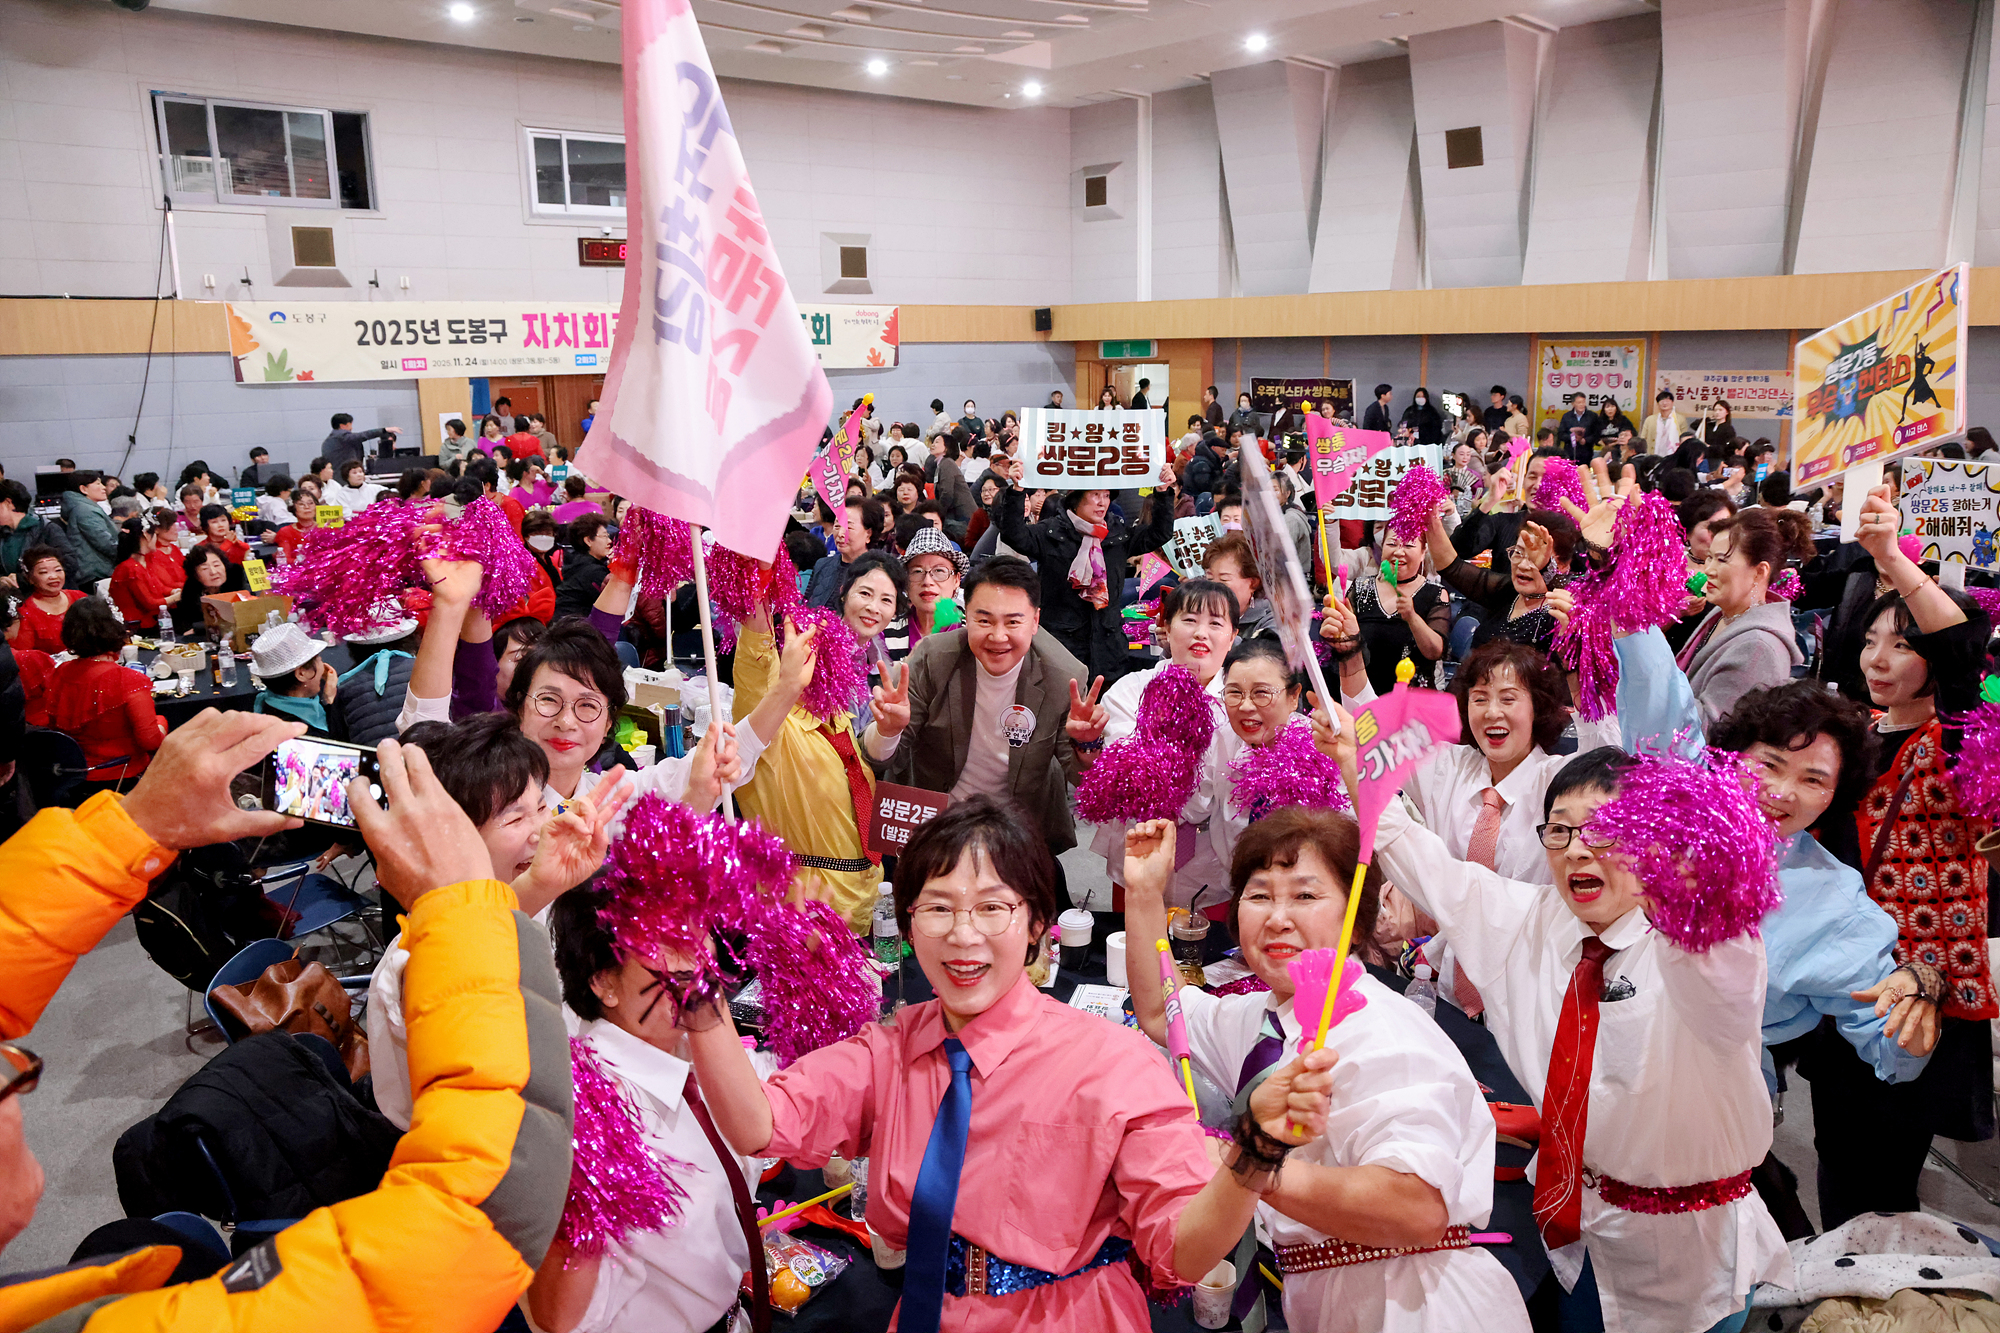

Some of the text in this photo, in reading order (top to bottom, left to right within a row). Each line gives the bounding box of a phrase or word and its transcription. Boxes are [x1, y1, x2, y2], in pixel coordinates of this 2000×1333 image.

[292, 312, 327, 325] 도봉구
[856, 309, 879, 318] dobong
[355, 312, 831, 349] 2025년 도봉구 자치회 회
[380, 360, 398, 370] 일시
[1825, 341, 1877, 385] 쌍문2동
[1675, 386, 1725, 401] 춤신춤왕
[1047, 422, 1142, 444] 킹 왕 짱
[1917, 422, 1928, 434] 댄스
[1037, 444, 1150, 476] 쌍문2동
[1375, 458, 1392, 478] 왕
[1949, 484, 1967, 493] 너~무
[1911, 497, 1991, 514] 쌍문2동 잘하는거
[1915, 515, 1985, 537] 2해해줘~
[880, 797, 938, 825] 쌍문2동
[881, 823, 911, 844] (발표
